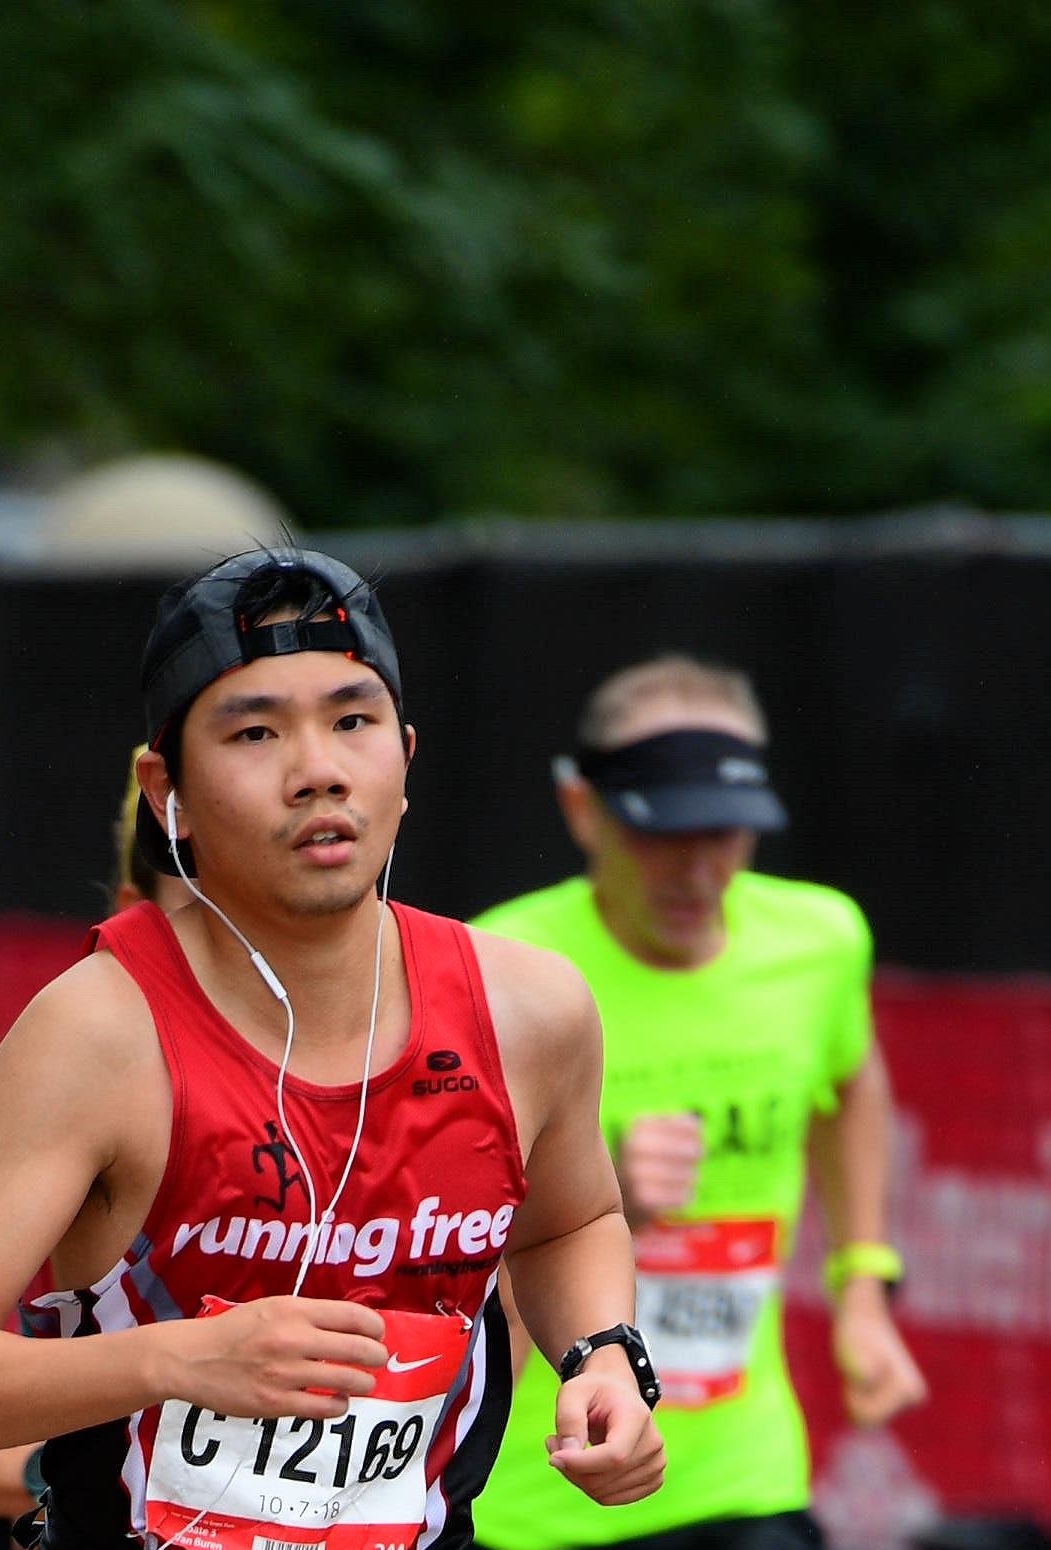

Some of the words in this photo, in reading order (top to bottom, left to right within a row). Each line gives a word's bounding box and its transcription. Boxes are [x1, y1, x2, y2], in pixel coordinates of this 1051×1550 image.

[171, 1210, 399, 1277] running
[410, 1196, 514, 1259] free
[180, 1402, 227, 1467] C
[251, 1413, 425, 1489] 12169
